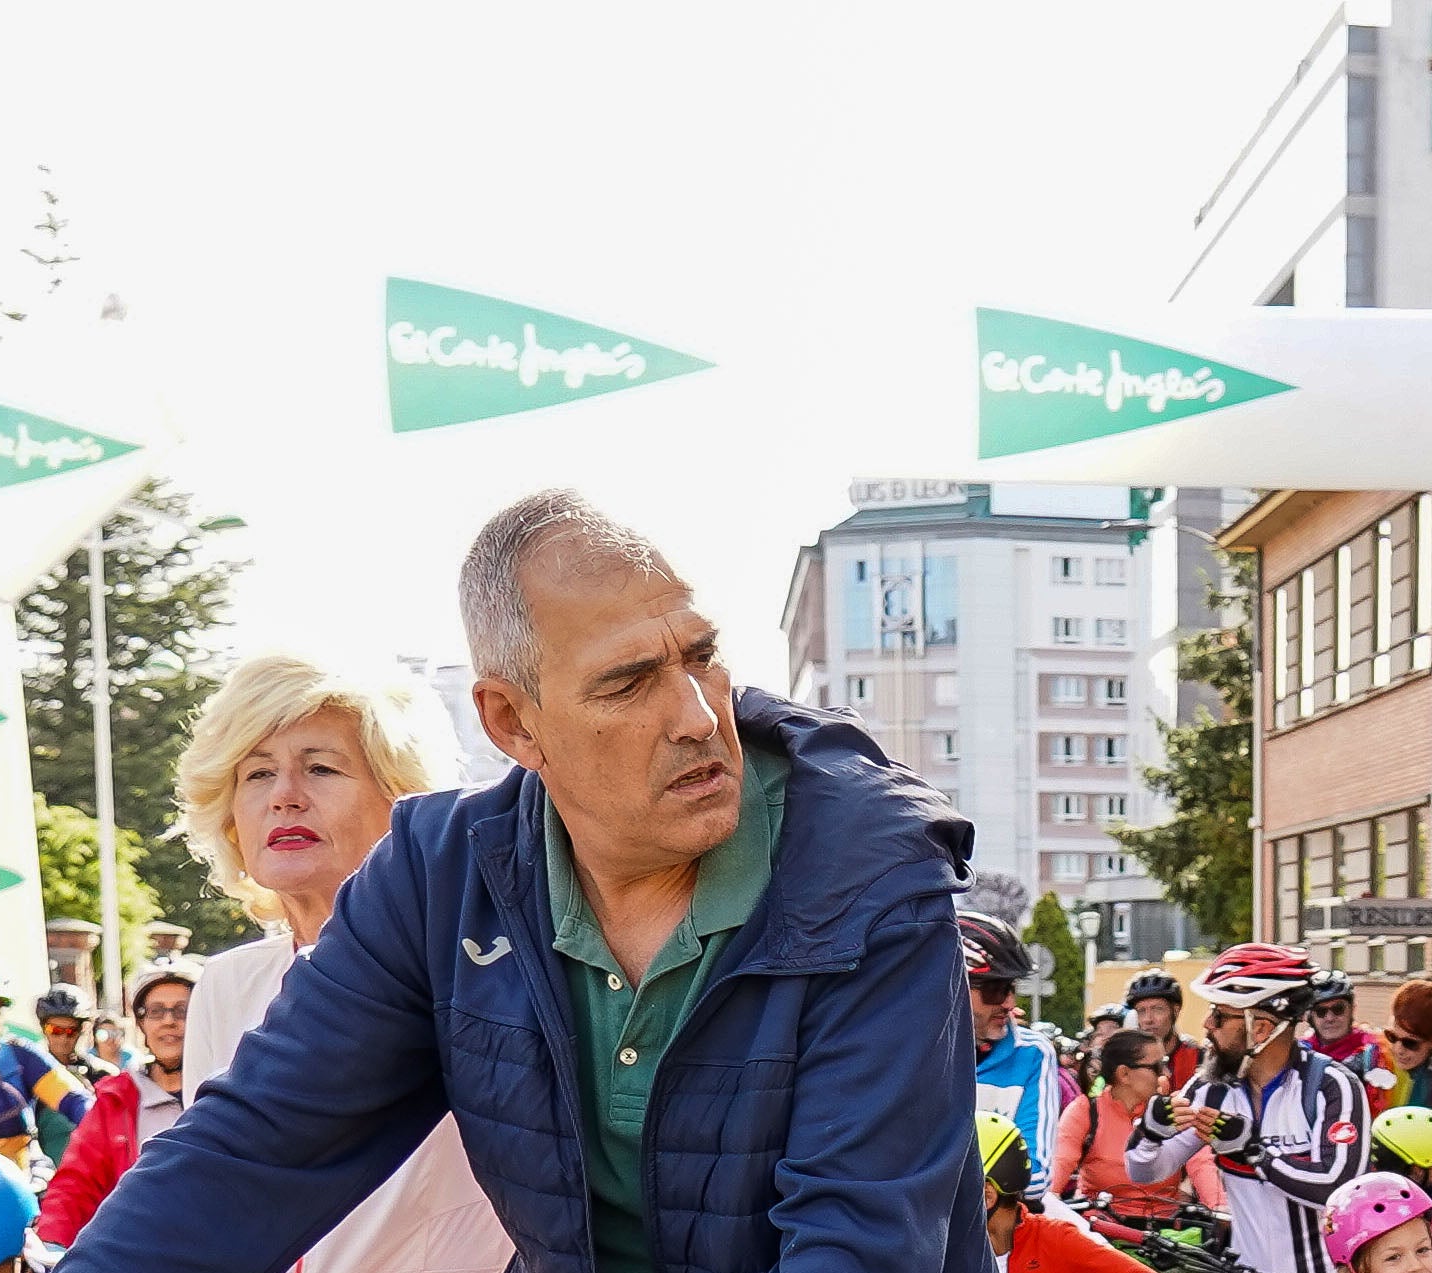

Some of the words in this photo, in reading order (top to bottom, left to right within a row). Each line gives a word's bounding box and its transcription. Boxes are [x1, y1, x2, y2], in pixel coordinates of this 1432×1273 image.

[982, 350, 1020, 392] El
[1019, 354, 1104, 397] Corte
[1104, 349, 1227, 413] Inglés
